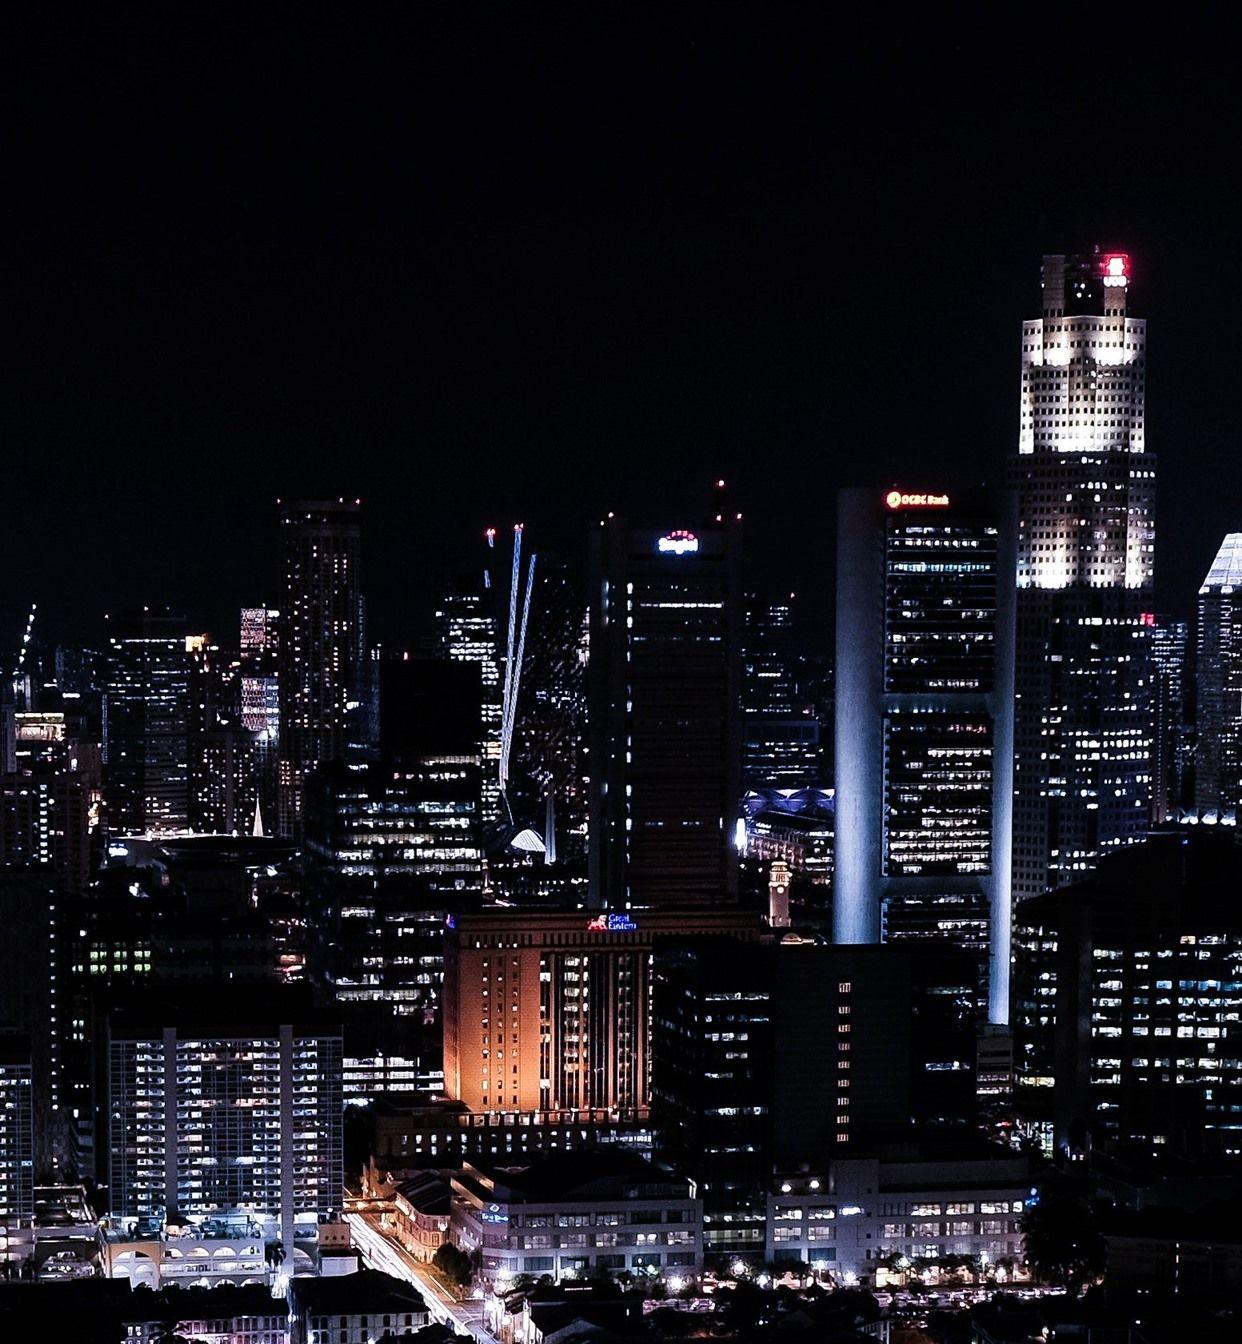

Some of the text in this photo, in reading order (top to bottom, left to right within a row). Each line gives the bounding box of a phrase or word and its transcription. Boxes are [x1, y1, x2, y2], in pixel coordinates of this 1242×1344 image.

[901, 495, 949, 505] OCBC Bank
[609, 913, 629, 922] Great
[609, 921, 637, 930] Eastern
